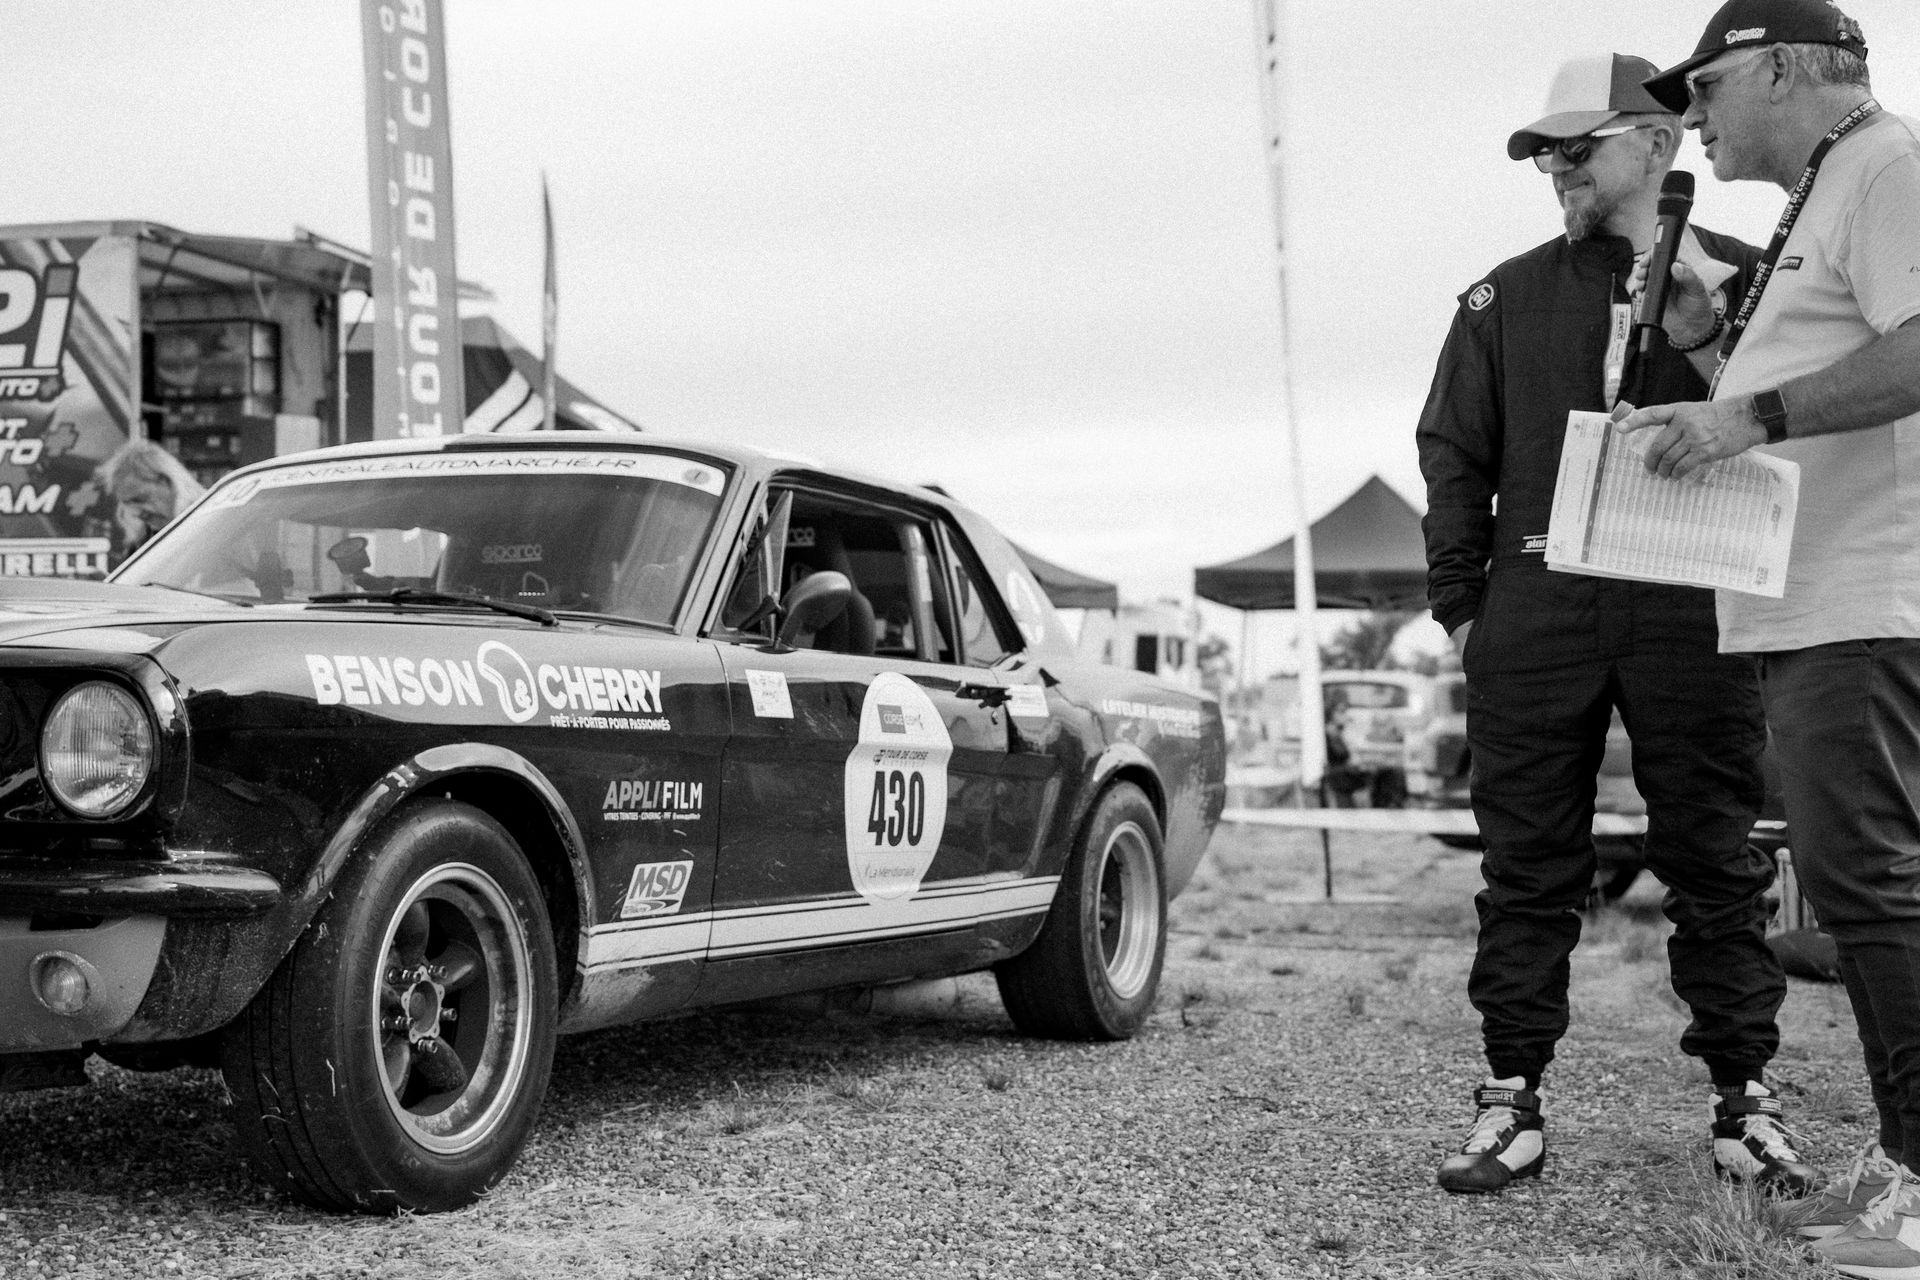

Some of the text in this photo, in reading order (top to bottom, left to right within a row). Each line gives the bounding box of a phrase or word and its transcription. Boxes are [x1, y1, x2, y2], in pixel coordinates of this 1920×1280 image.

[1834, 116, 1853, 131] TOUR
[1850, 109, 1862, 118] DE
[1780, 166, 1812, 224] TOUR DE CORSE
[1738, 262, 1768, 316] TOUR DE CORSE
[0, 551, 109, 577] RELLI
[482, 544, 543, 563] sparco
[305, 654, 484, 706] BENSON
[538, 664, 663, 713] CHERRY
[608, 717, 629, 730] POUR
[629, 716, 671, 731] PASSIONNÉS
[867, 770, 925, 847] 430
[629, 864, 687, 899] MSD
